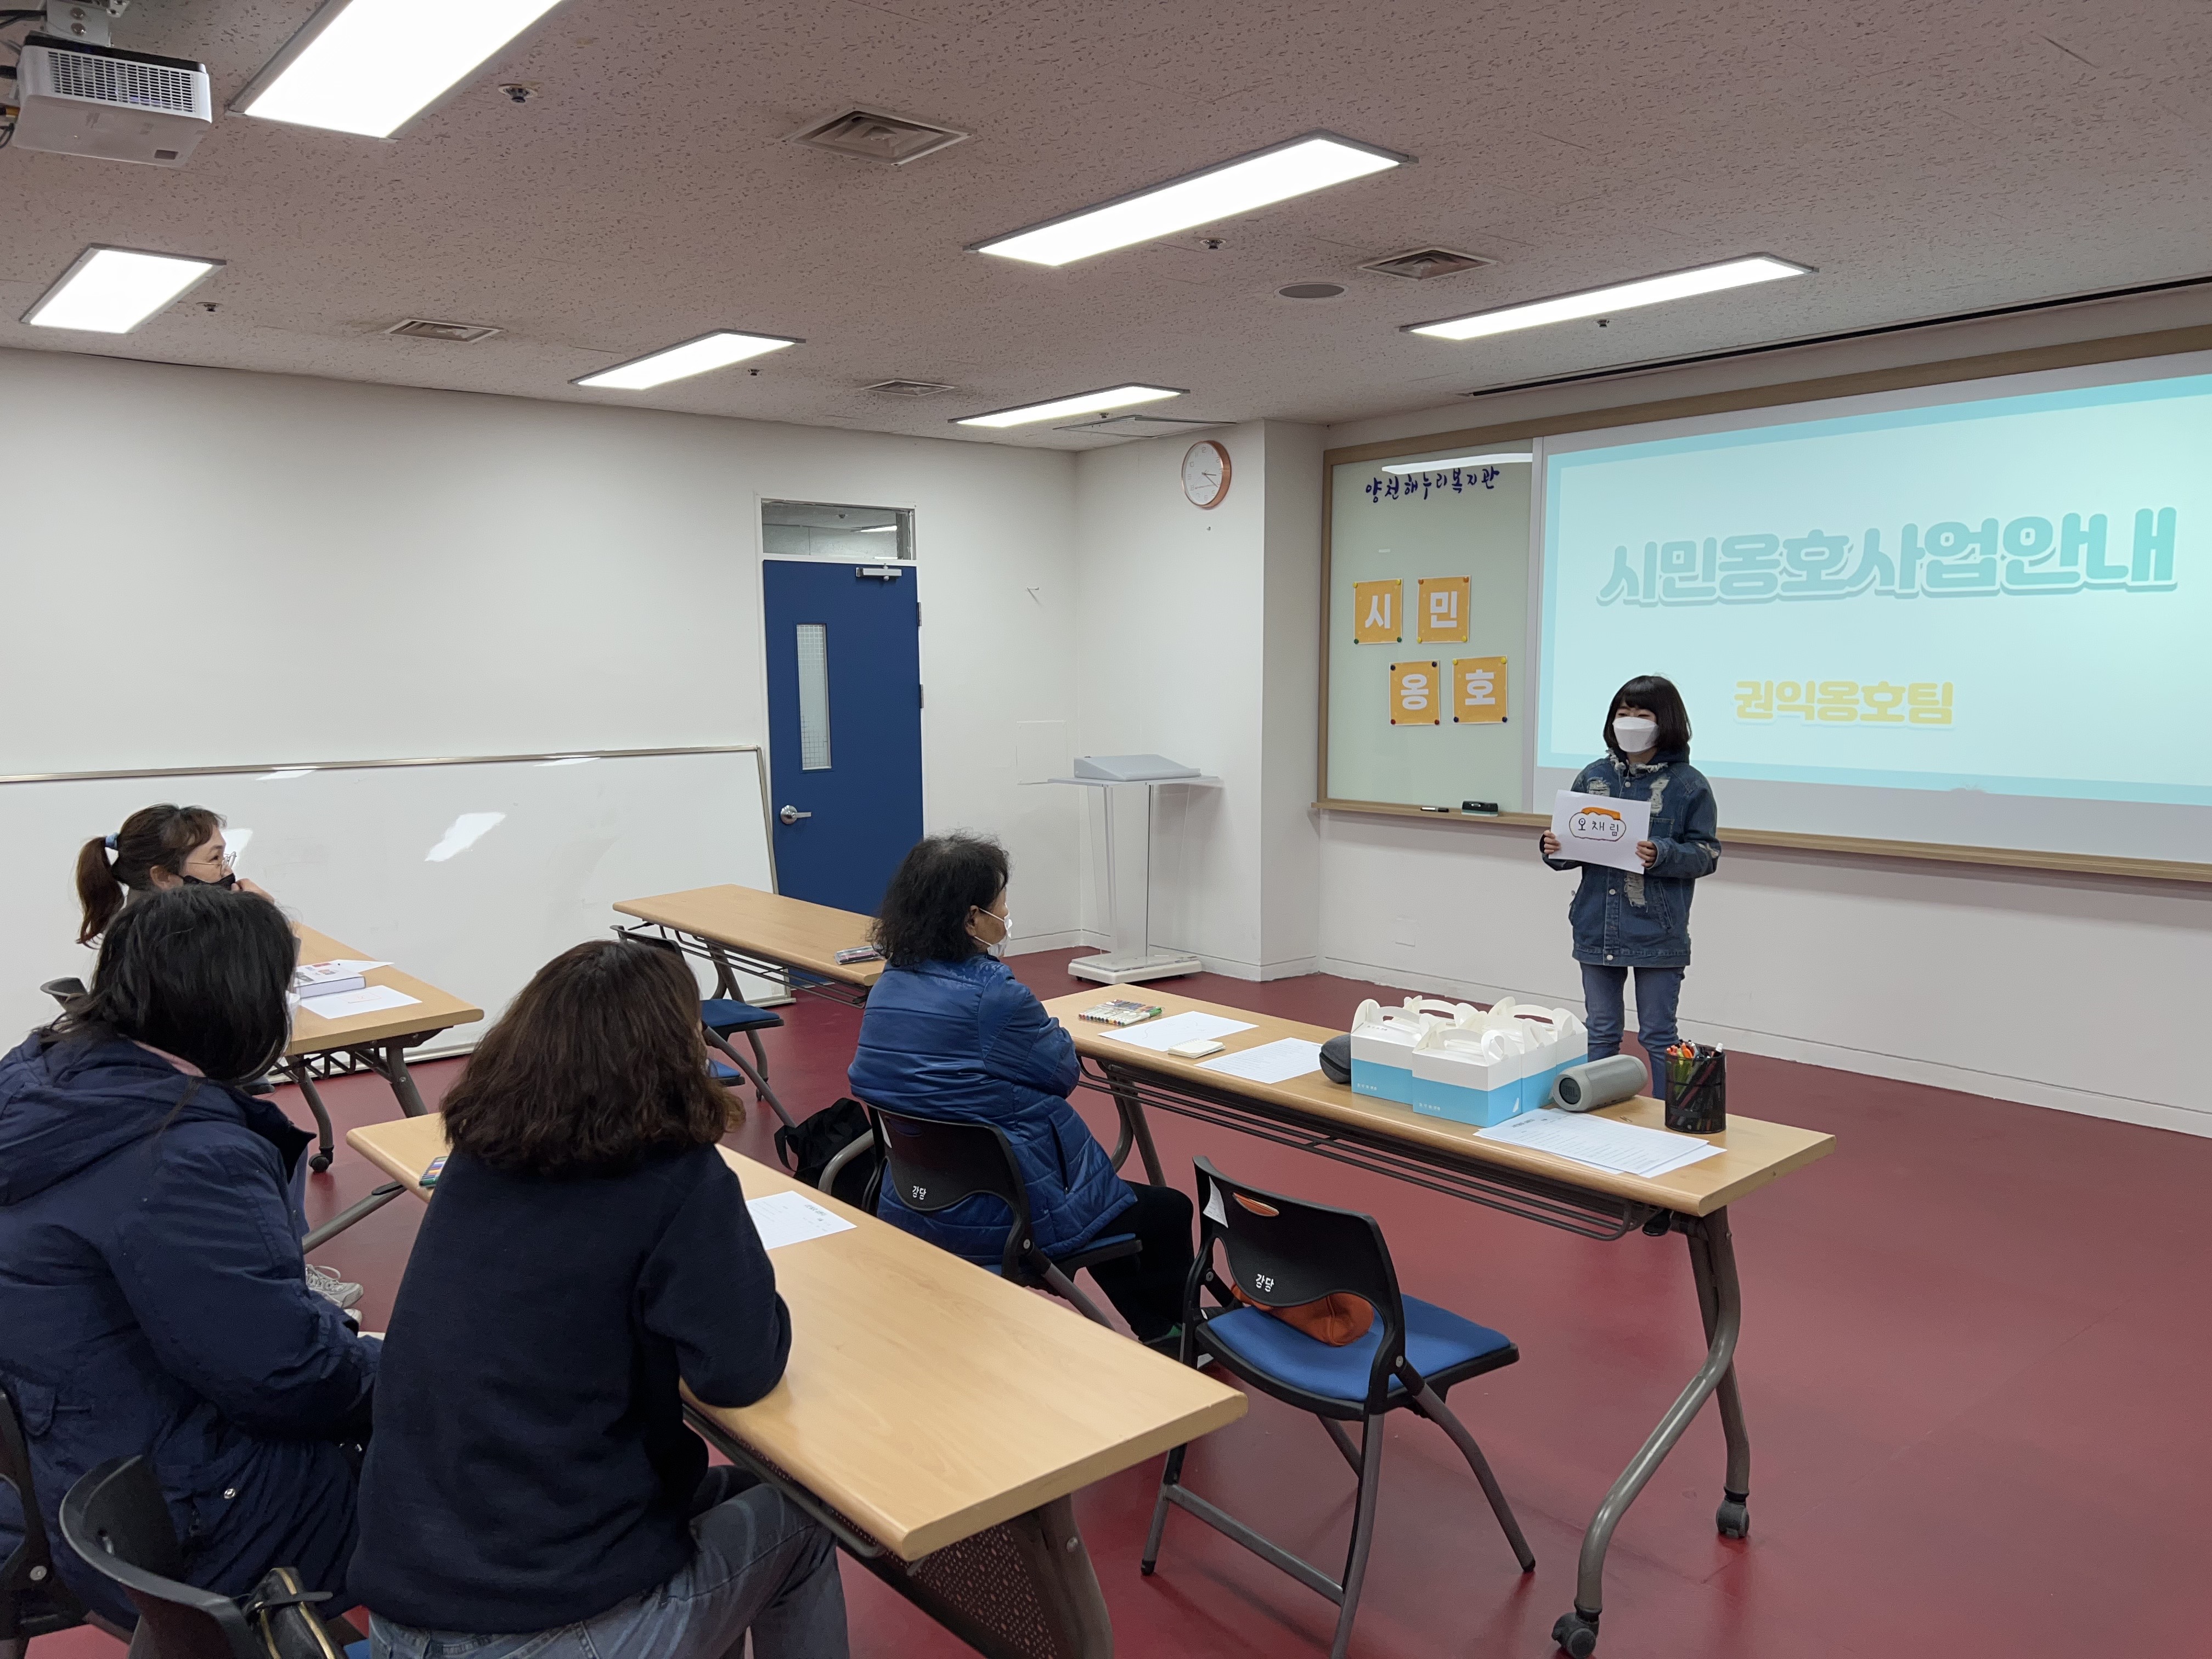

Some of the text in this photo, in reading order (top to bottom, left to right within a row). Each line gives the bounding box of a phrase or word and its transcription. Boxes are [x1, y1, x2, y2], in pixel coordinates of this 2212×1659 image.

[1365, 466, 1500, 503] 양천해누리복지관
[1596, 506, 2178, 607] 시민옹호사업안내
[1734, 680, 1955, 727] 권익옹호팀
[912, 1185, 927, 1200] 강당
[1255, 1273, 1274, 1293] 강당
